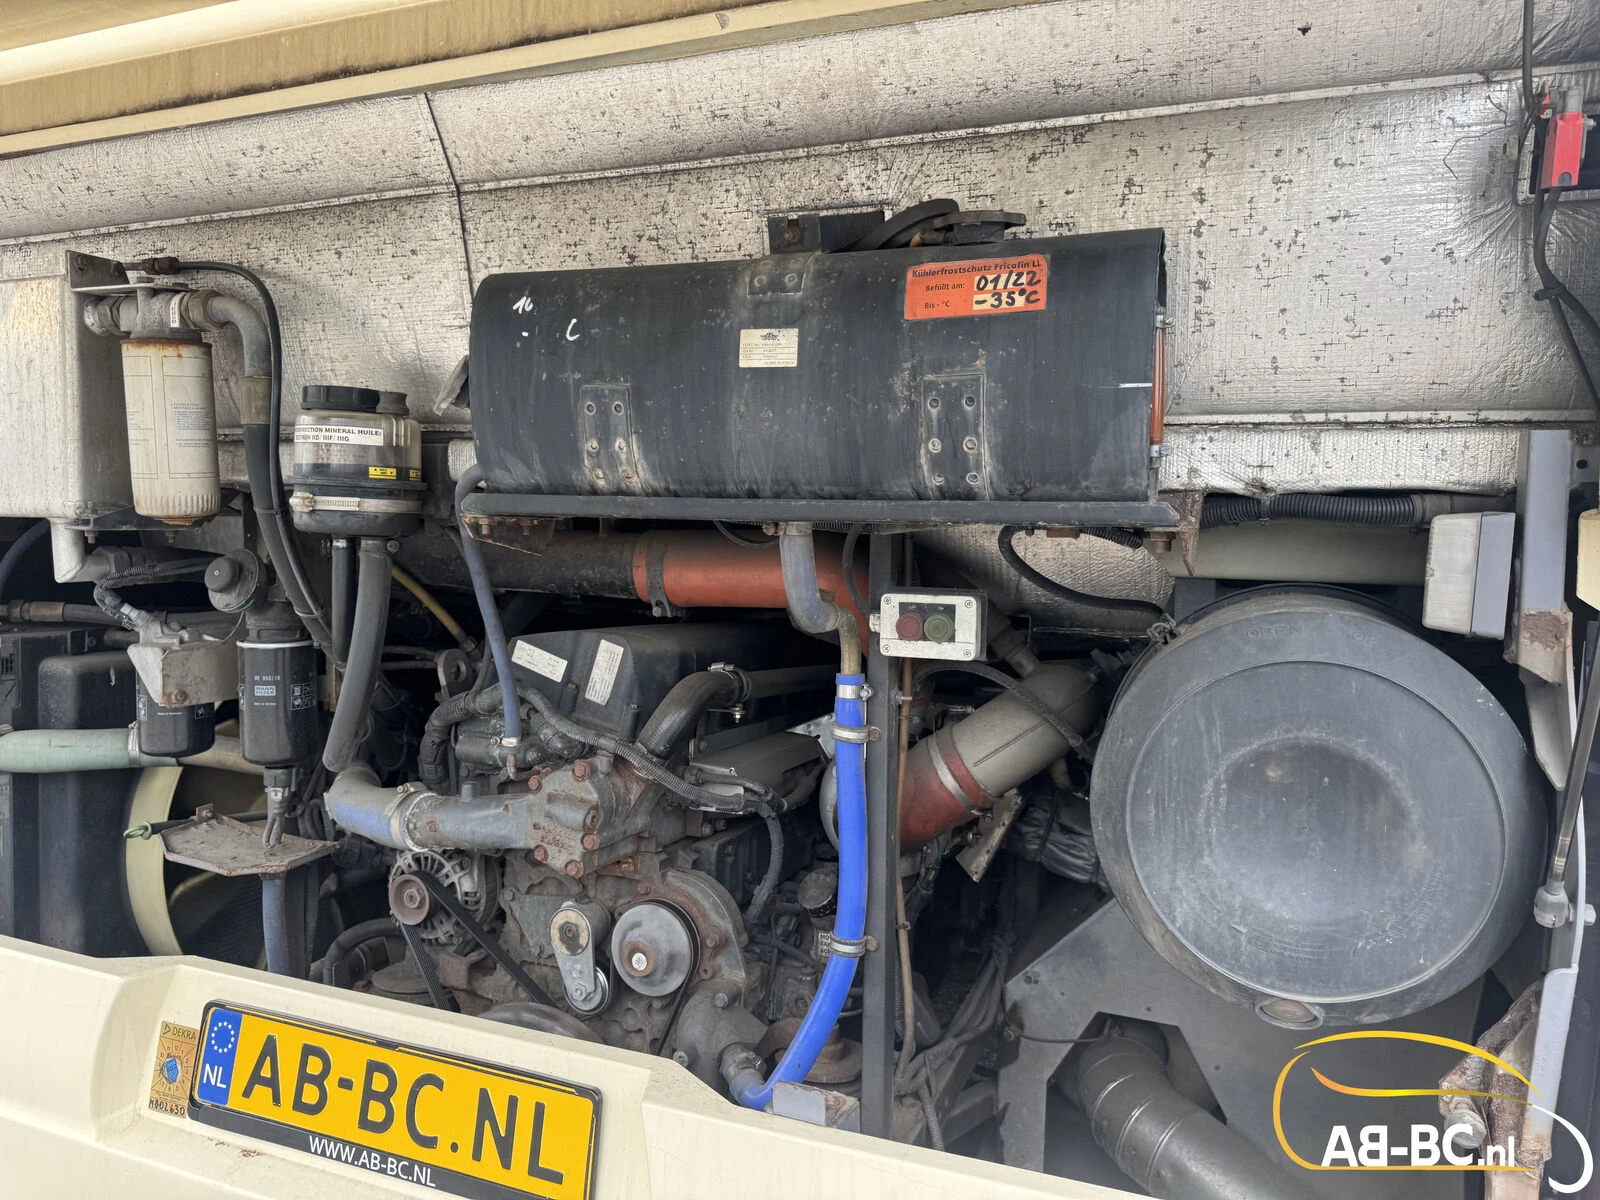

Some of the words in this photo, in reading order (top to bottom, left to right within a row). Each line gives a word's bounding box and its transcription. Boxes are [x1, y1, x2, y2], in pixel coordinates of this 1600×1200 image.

[912, 264, 992, 278] Kühlerfrostschutz
[994, 261, 1030, 271] Fricofin
[925, 283, 950, 292] Befüllt
[975, 269, 1042, 292] 01/22
[924, 302, 935, 310] Bis
[324, 427, 356, 435] MINERAL
[171, 1026, 197, 1041] DEKRA
[202, 1063, 227, 1089] NL
[241, 1033, 564, 1186] AB-BC.NL
[309, 1135, 436, 1188] WWW.AB-BC.NL
